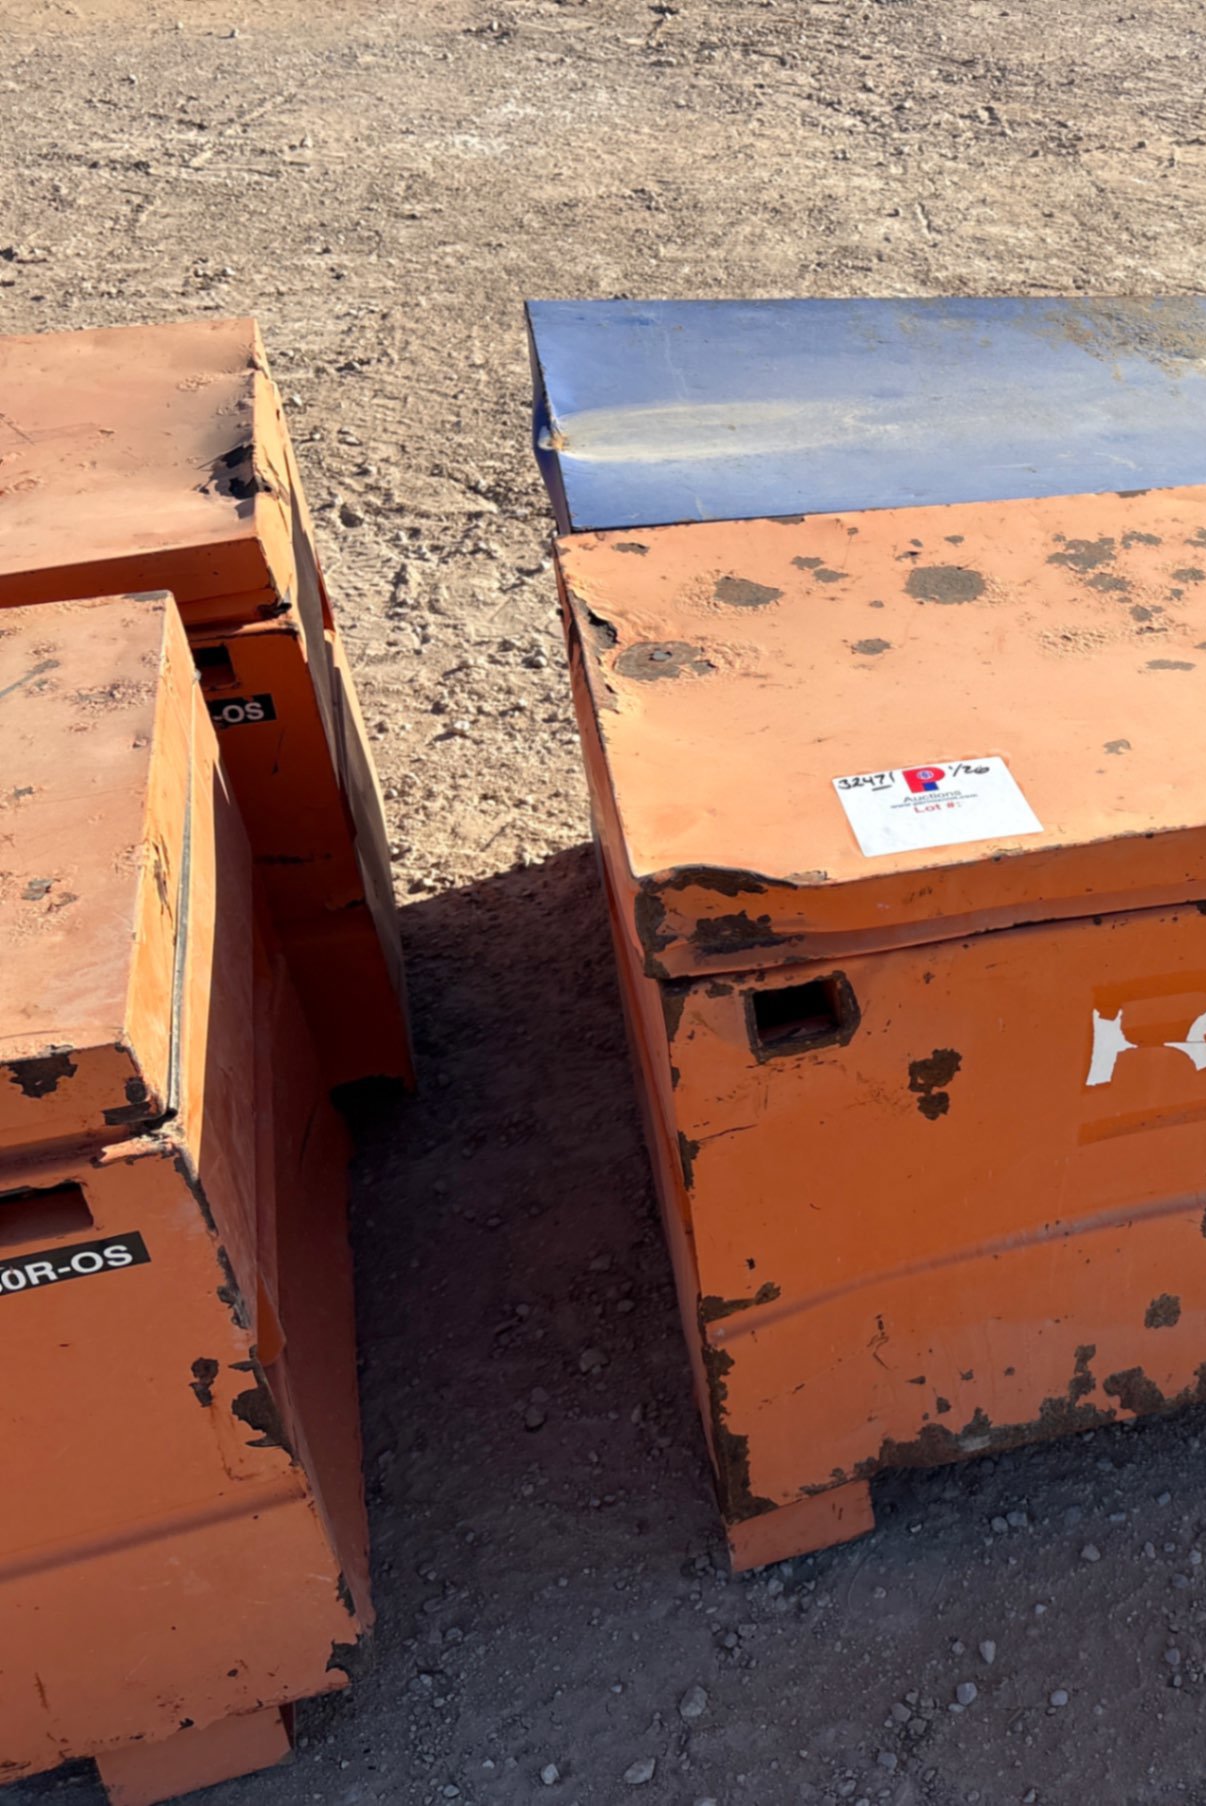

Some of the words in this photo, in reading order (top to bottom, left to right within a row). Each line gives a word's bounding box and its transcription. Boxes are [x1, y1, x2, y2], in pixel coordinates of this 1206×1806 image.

[212, 701, 264, 723] -OS
[838, 771, 895, 791] 32471
[903, 790, 962, 803] Auctions
[913, 803, 942, 814] Lot
